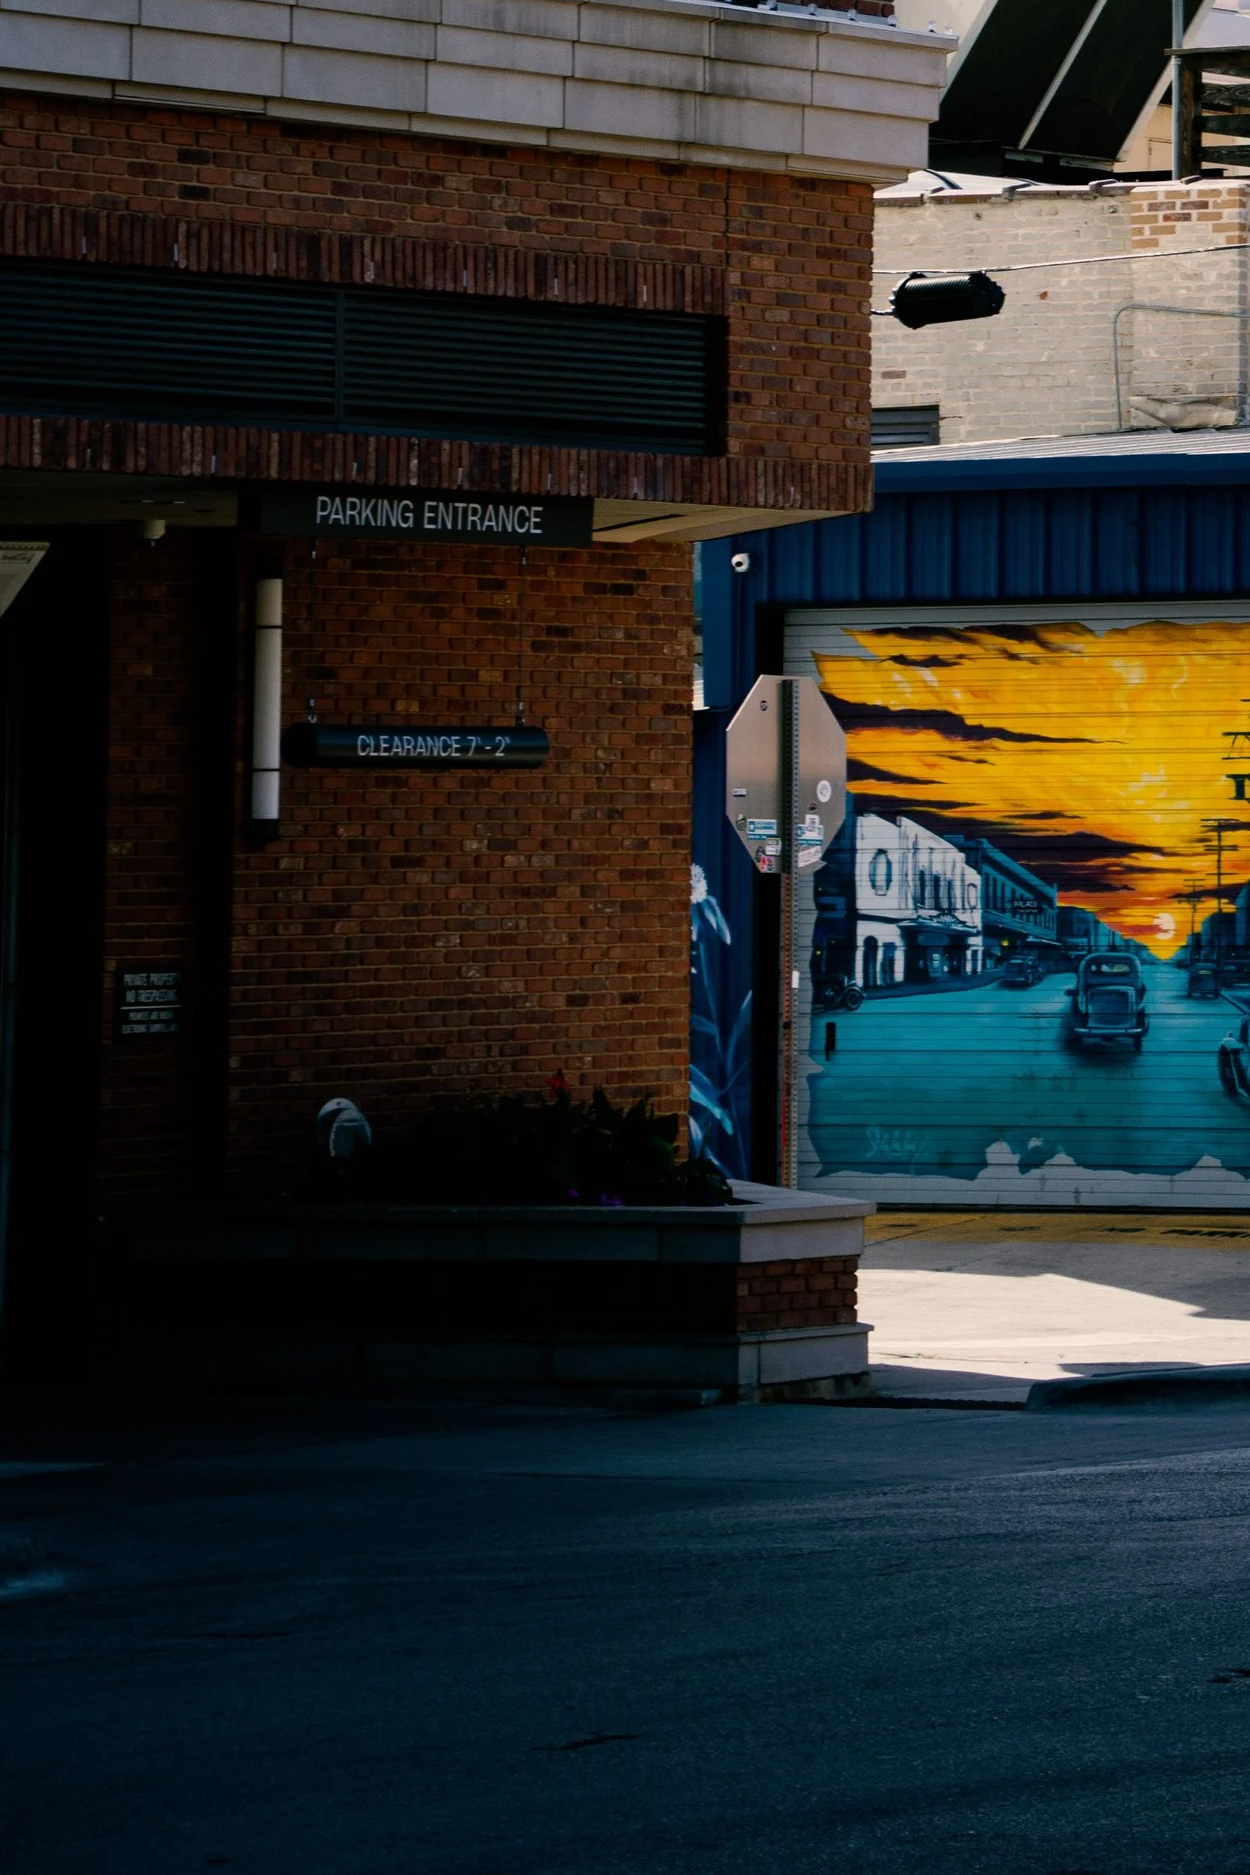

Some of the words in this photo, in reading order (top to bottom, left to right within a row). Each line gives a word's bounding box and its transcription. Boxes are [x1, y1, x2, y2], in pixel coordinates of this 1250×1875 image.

[315, 495, 414, 528] PARKING
[423, 501, 544, 534] ENTRANCE
[357, 735, 461, 757] CLEARANCE
